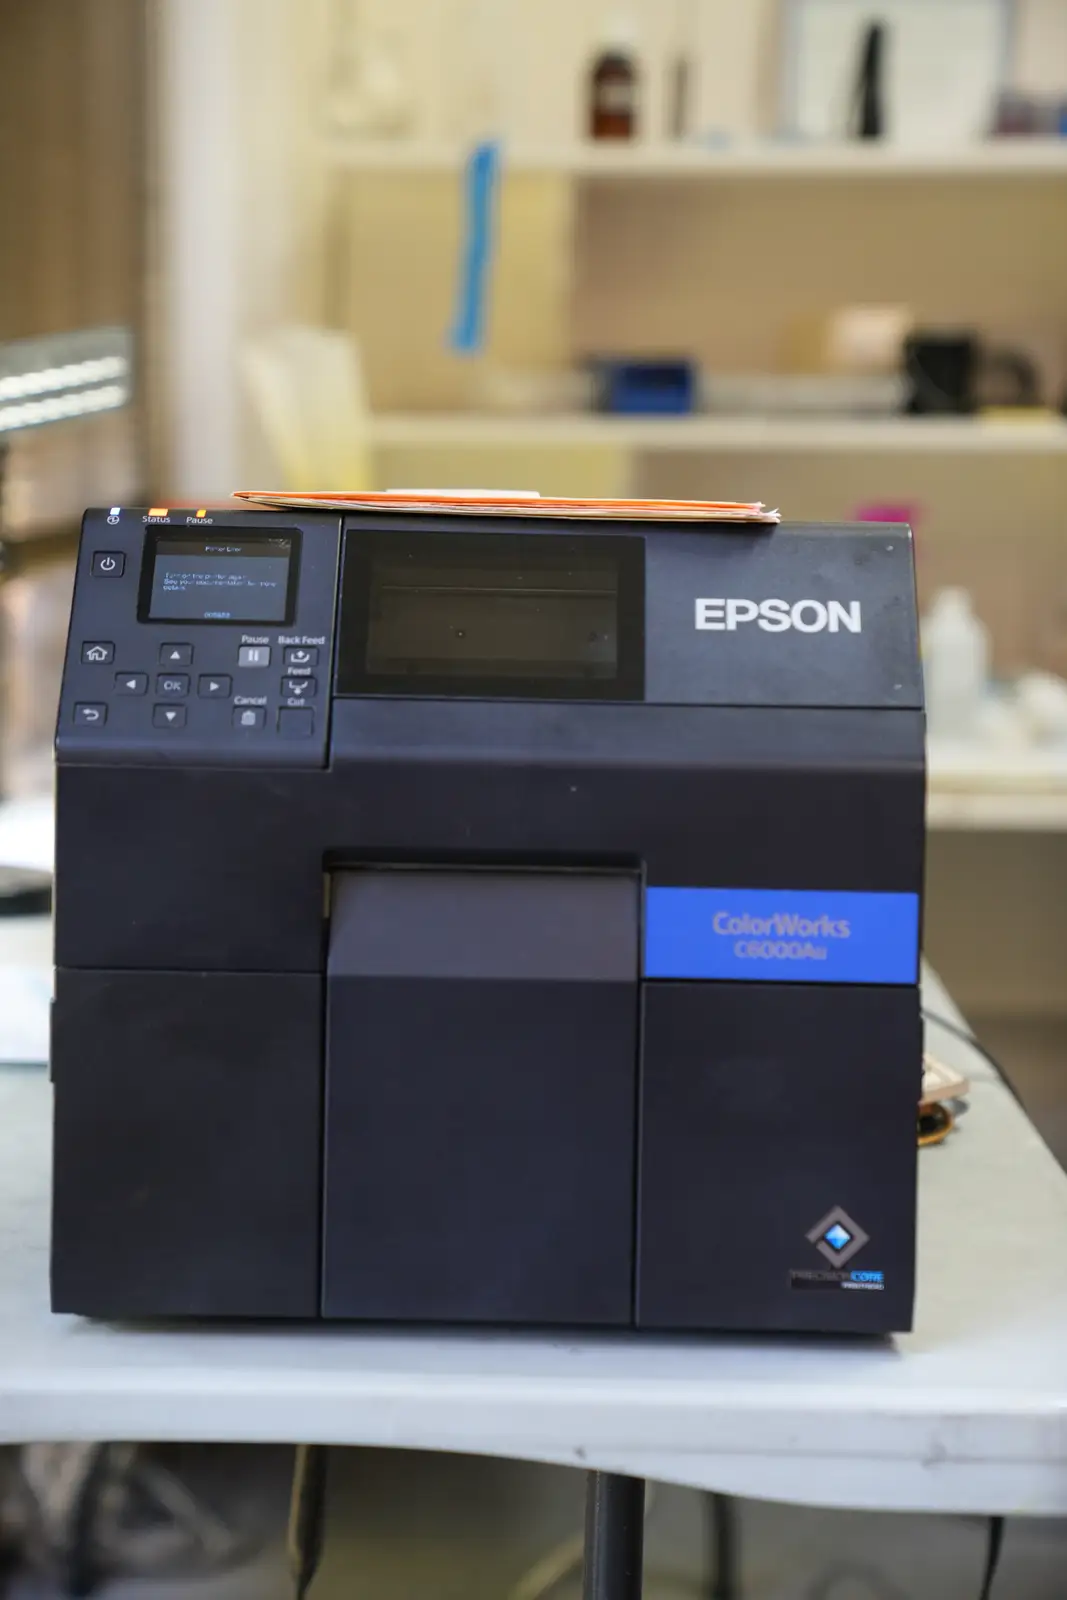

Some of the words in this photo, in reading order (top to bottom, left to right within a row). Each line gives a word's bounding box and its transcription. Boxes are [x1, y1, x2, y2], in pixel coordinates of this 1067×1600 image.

[142, 515, 171, 523] Status
[186, 516, 214, 524] Pause
[695, 598, 862, 633] EPSON
[241, 634, 269, 644] Pause
[278, 635, 300, 645] Back
[302, 635, 325, 645] Feed
[287, 666, 311, 675] Feed
[163, 680, 182, 691] OK
[234, 696, 267, 705] Cancel
[712, 911, 851, 938] ColorWorks
